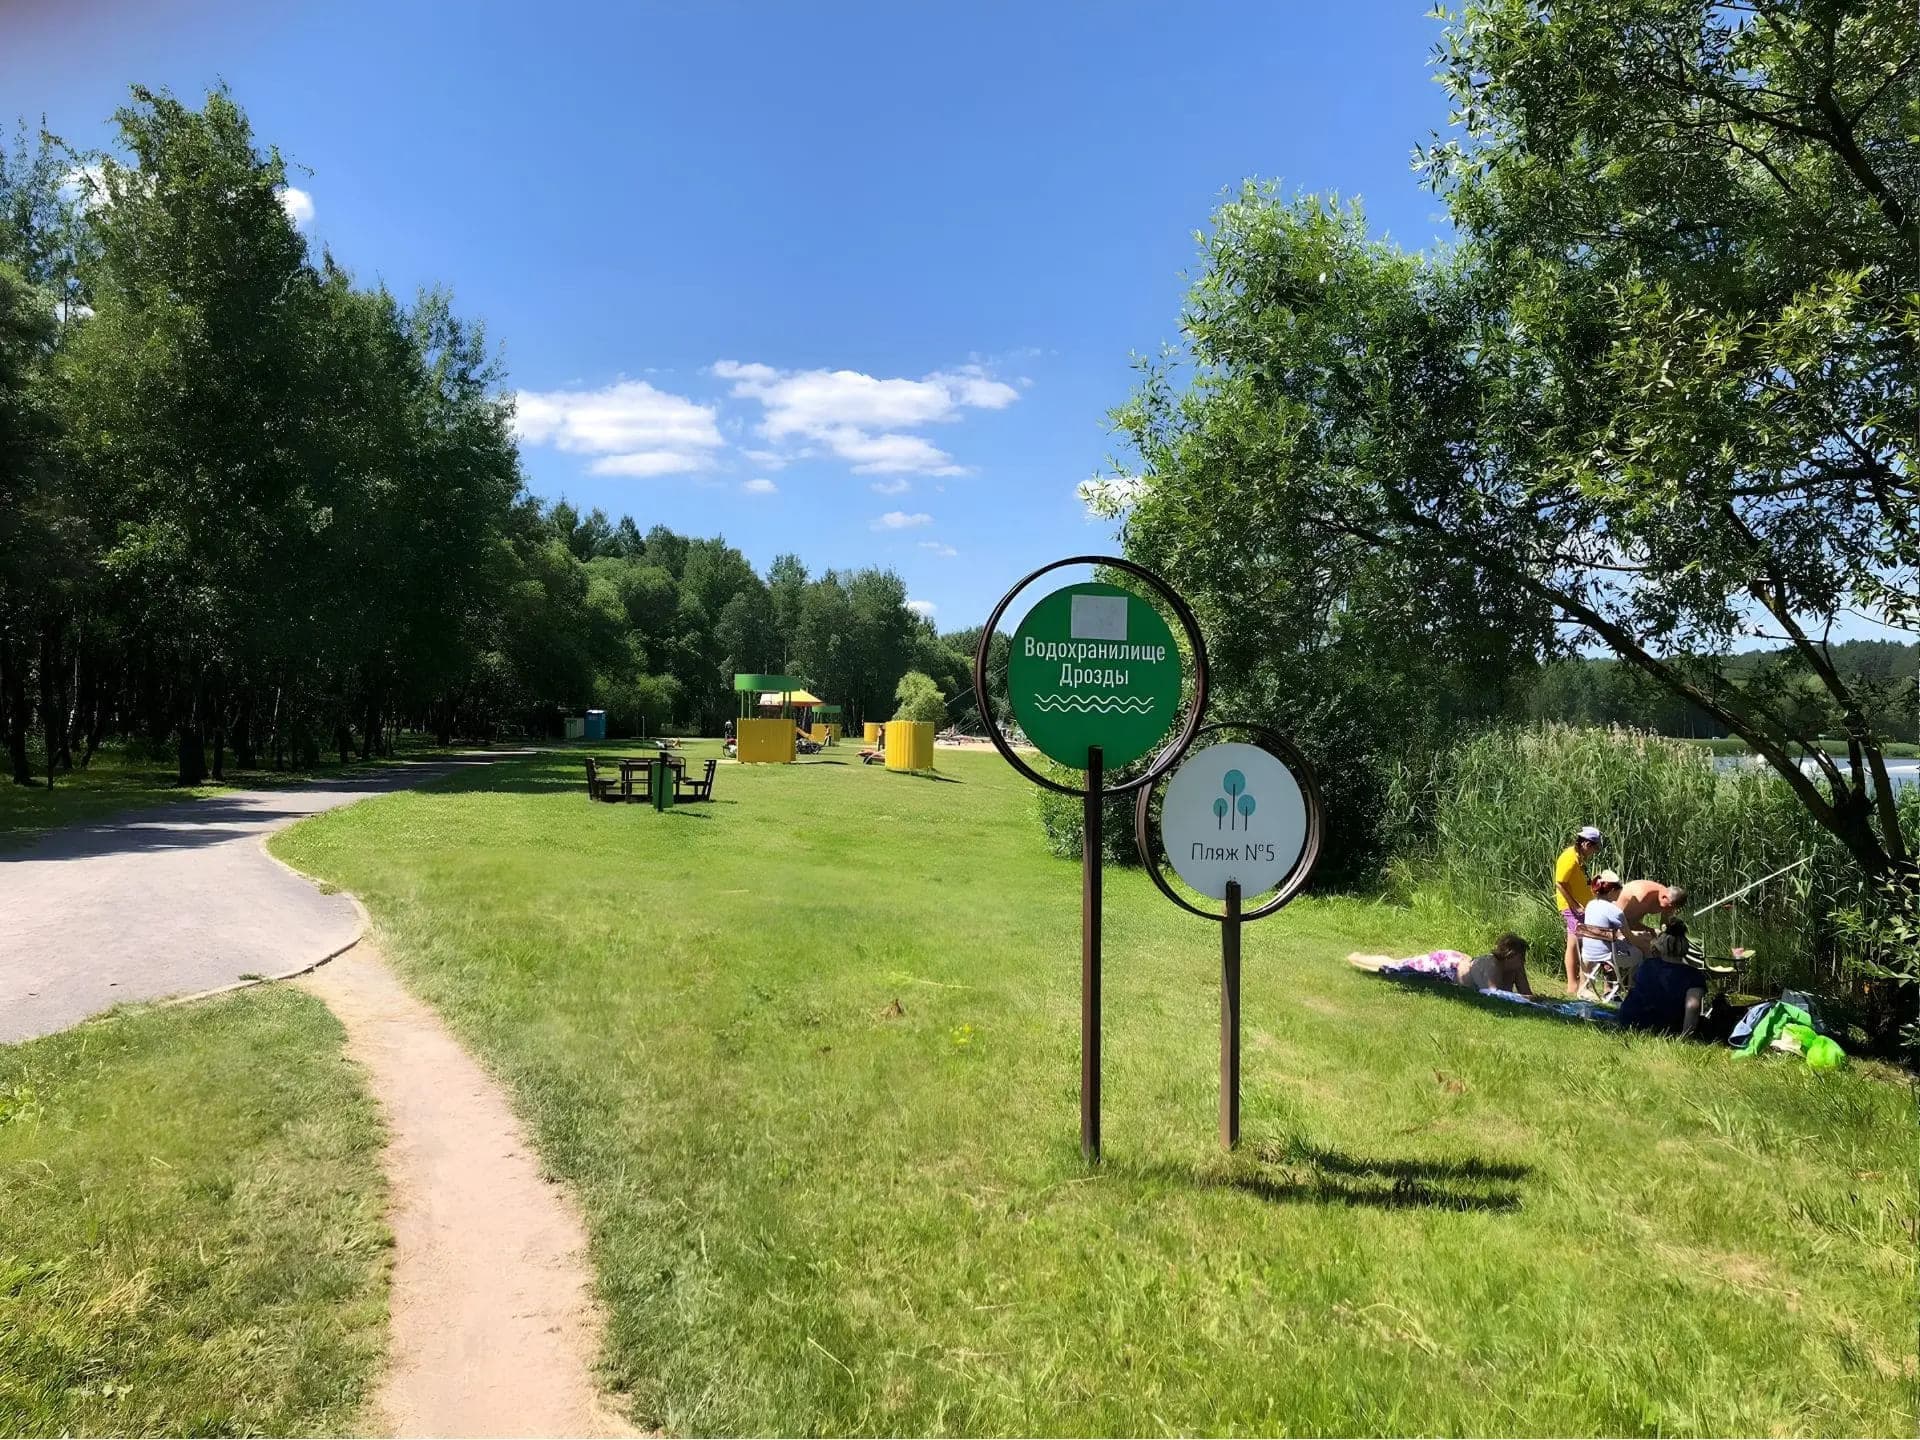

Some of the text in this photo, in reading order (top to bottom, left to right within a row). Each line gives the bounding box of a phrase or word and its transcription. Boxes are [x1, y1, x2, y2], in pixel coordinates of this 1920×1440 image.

[1024, 636, 1166, 664] Водохранилище
[1059, 663, 1129, 688] Дрозды
[1191, 842, 1240, 861] Пляж
